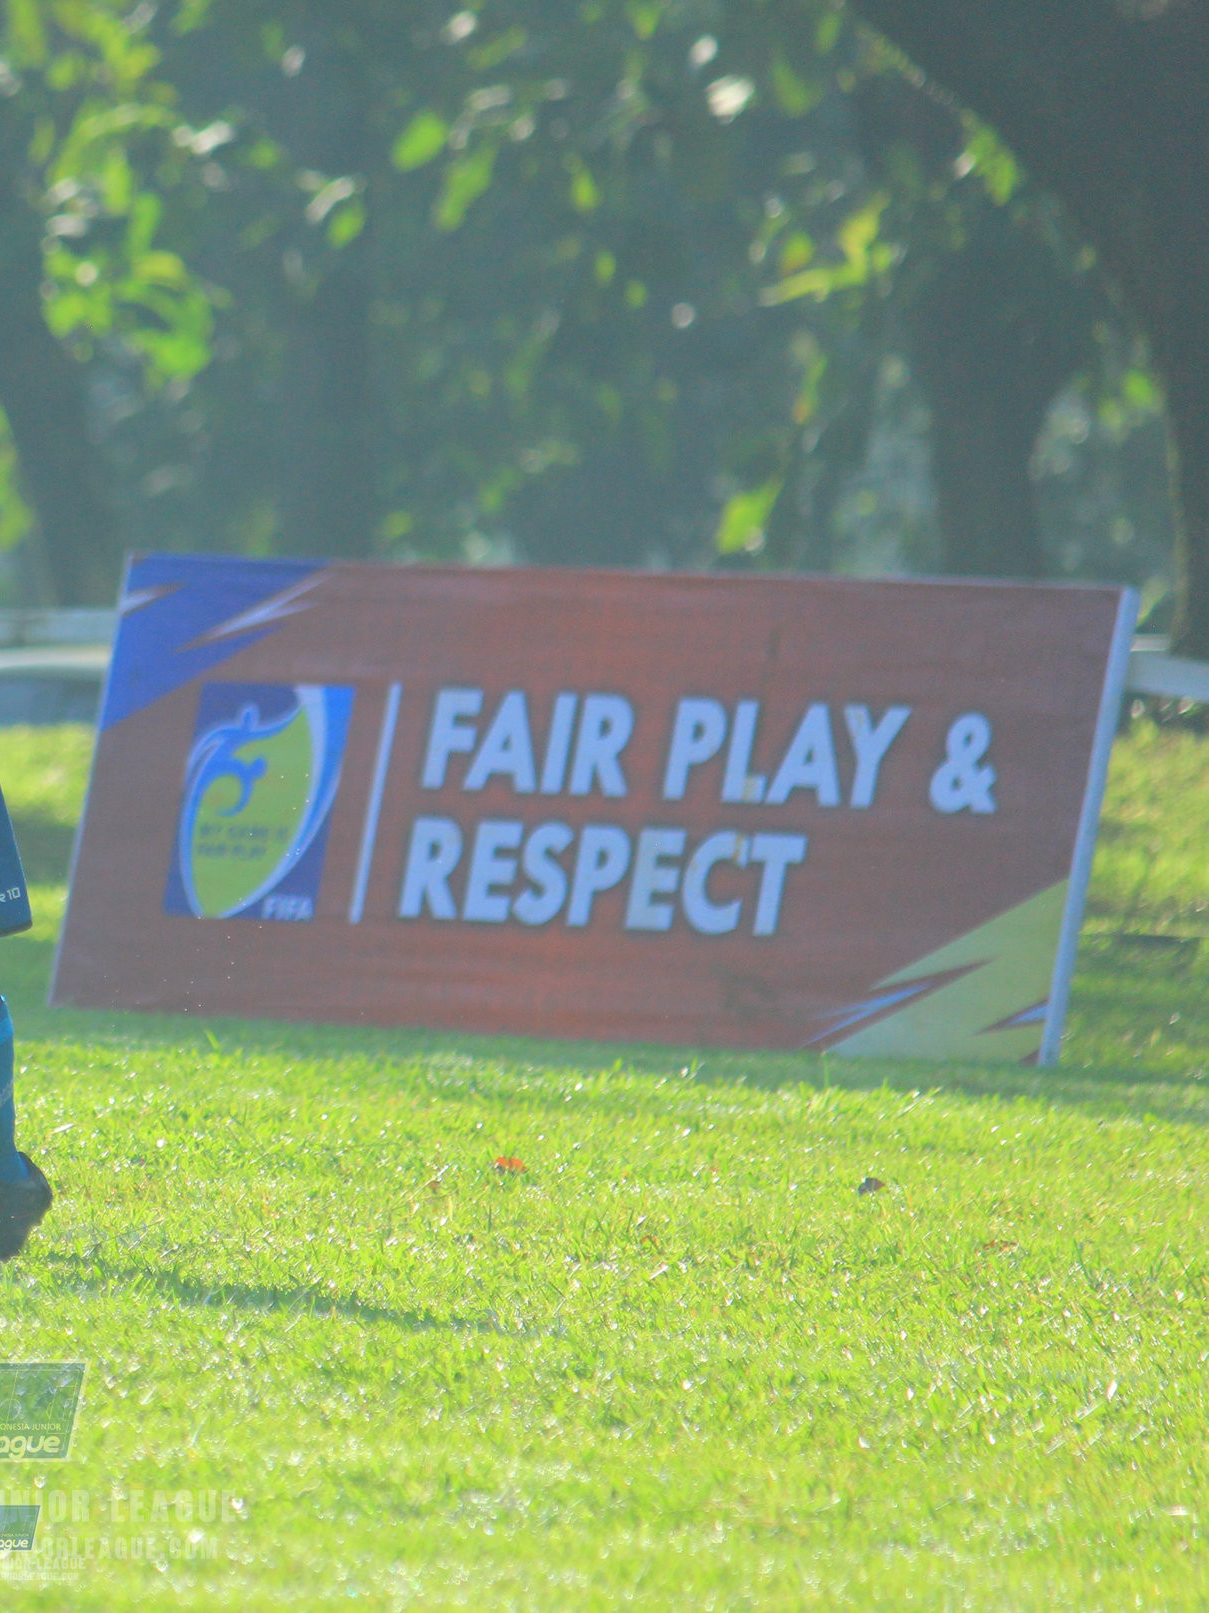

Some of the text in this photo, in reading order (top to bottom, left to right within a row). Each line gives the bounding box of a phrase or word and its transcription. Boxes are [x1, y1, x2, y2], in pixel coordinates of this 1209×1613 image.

[422, 688, 998, 816] FAIR PLAY &
[261, 895, 314, 922] FIFA
[400, 818, 805, 936] RESPECT
